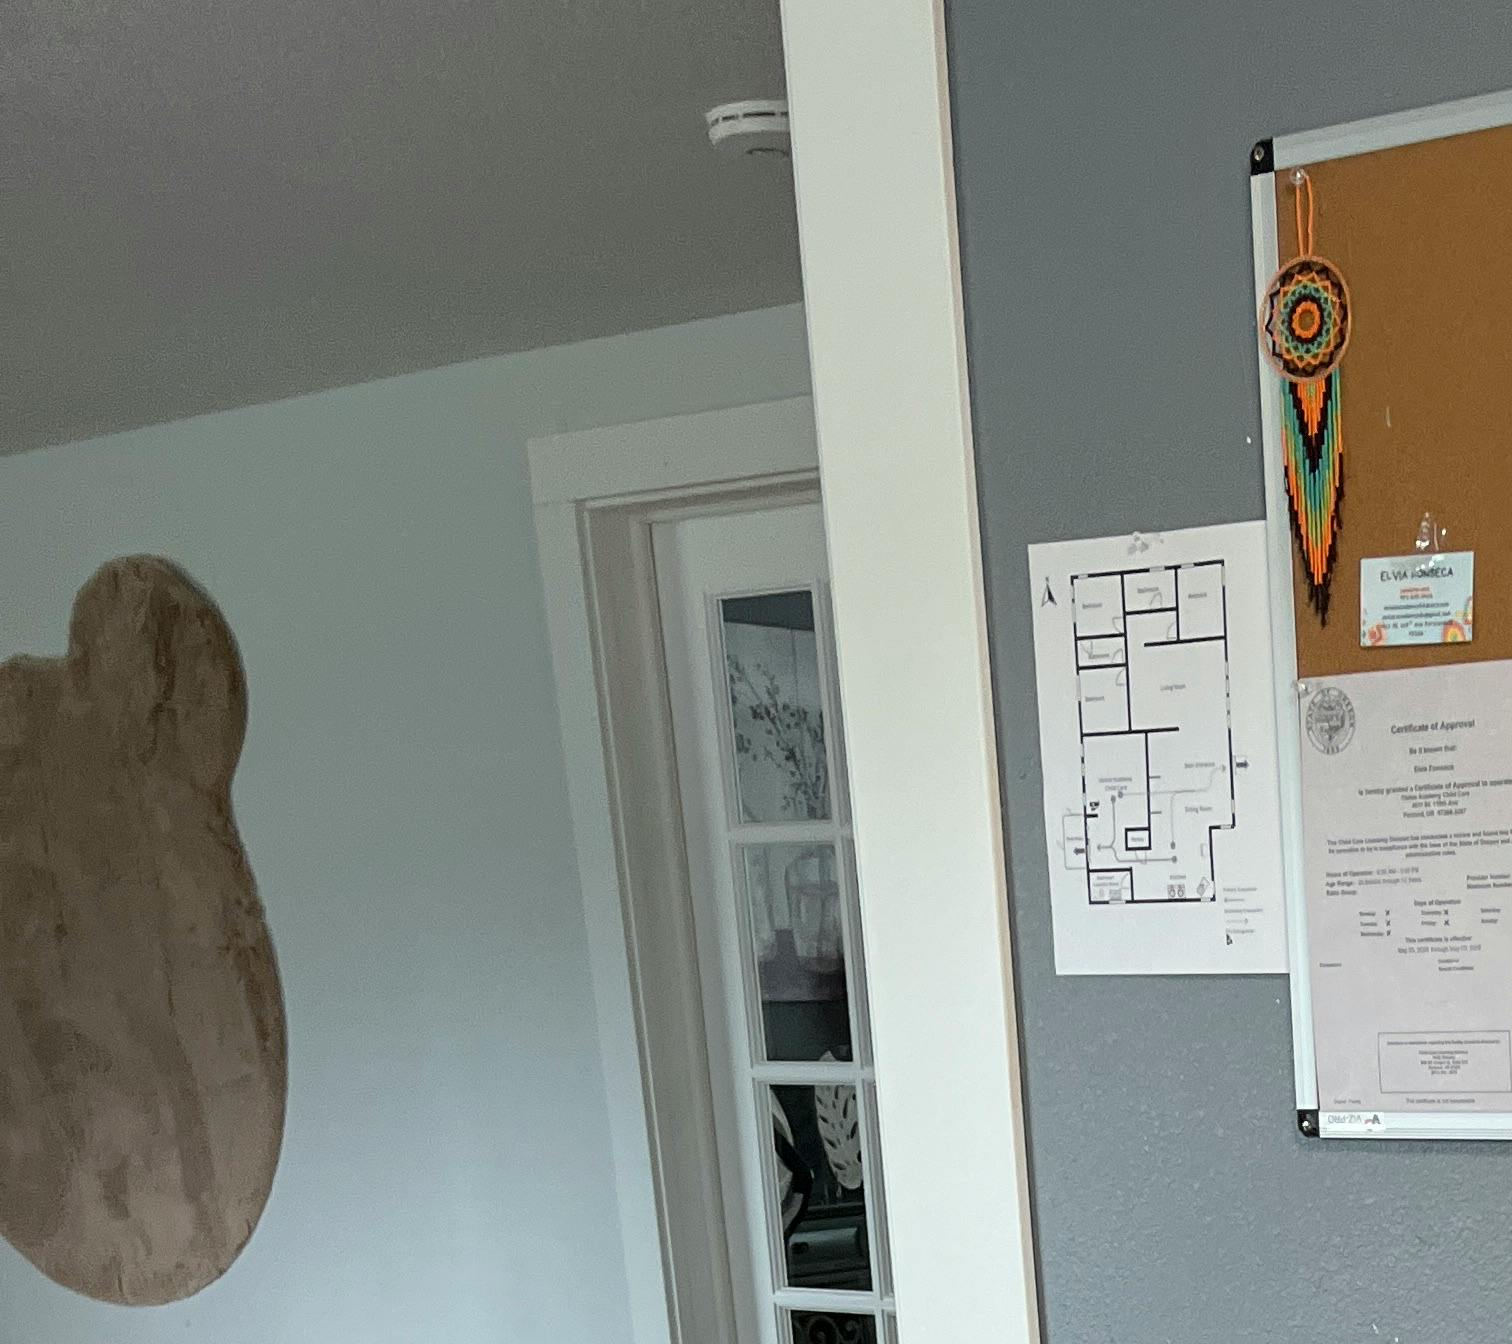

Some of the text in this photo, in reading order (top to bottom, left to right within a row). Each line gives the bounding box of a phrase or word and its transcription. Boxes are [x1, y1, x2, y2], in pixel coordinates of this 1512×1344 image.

[1390, 719, 1476, 735] Certificate of Approval
